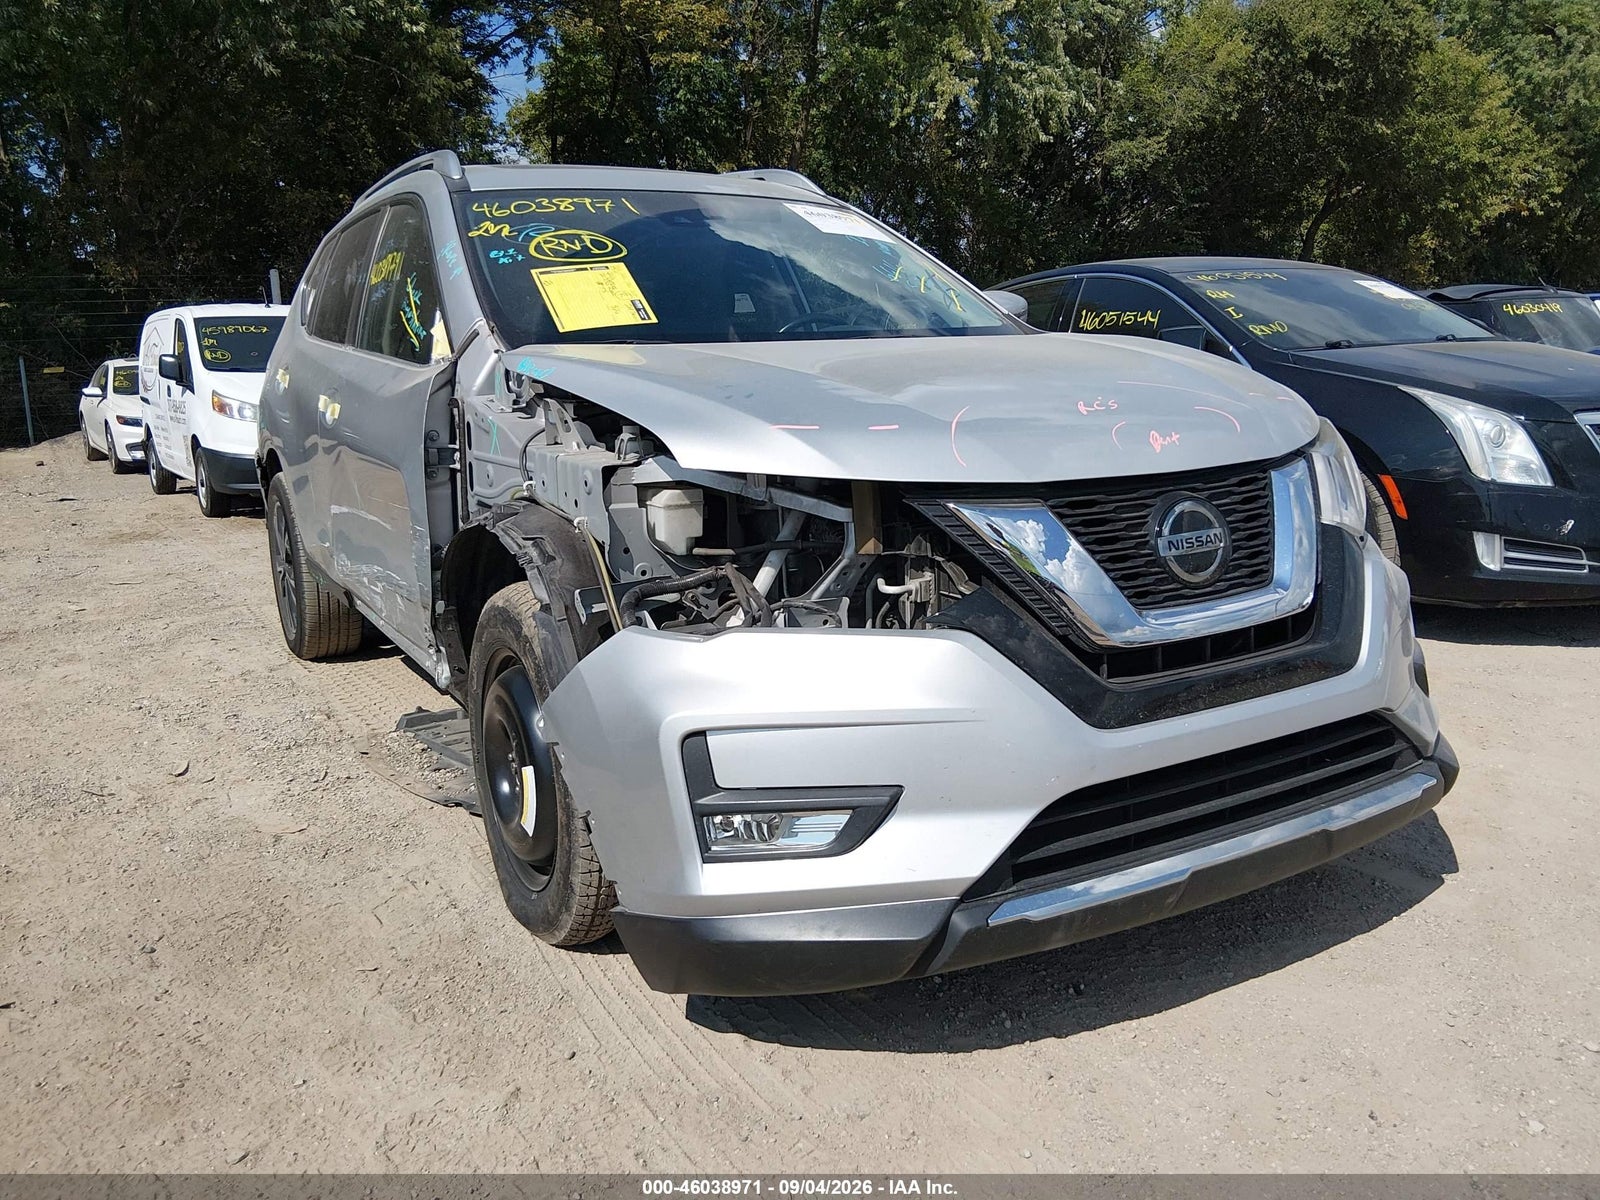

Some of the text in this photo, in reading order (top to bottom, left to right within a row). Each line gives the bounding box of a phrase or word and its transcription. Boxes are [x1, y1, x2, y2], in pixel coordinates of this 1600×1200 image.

[472, 197, 640, 218] 46038971
[1079, 309, 1161, 331] 46051544
[1168, 532, 1223, 552] NISSAN
